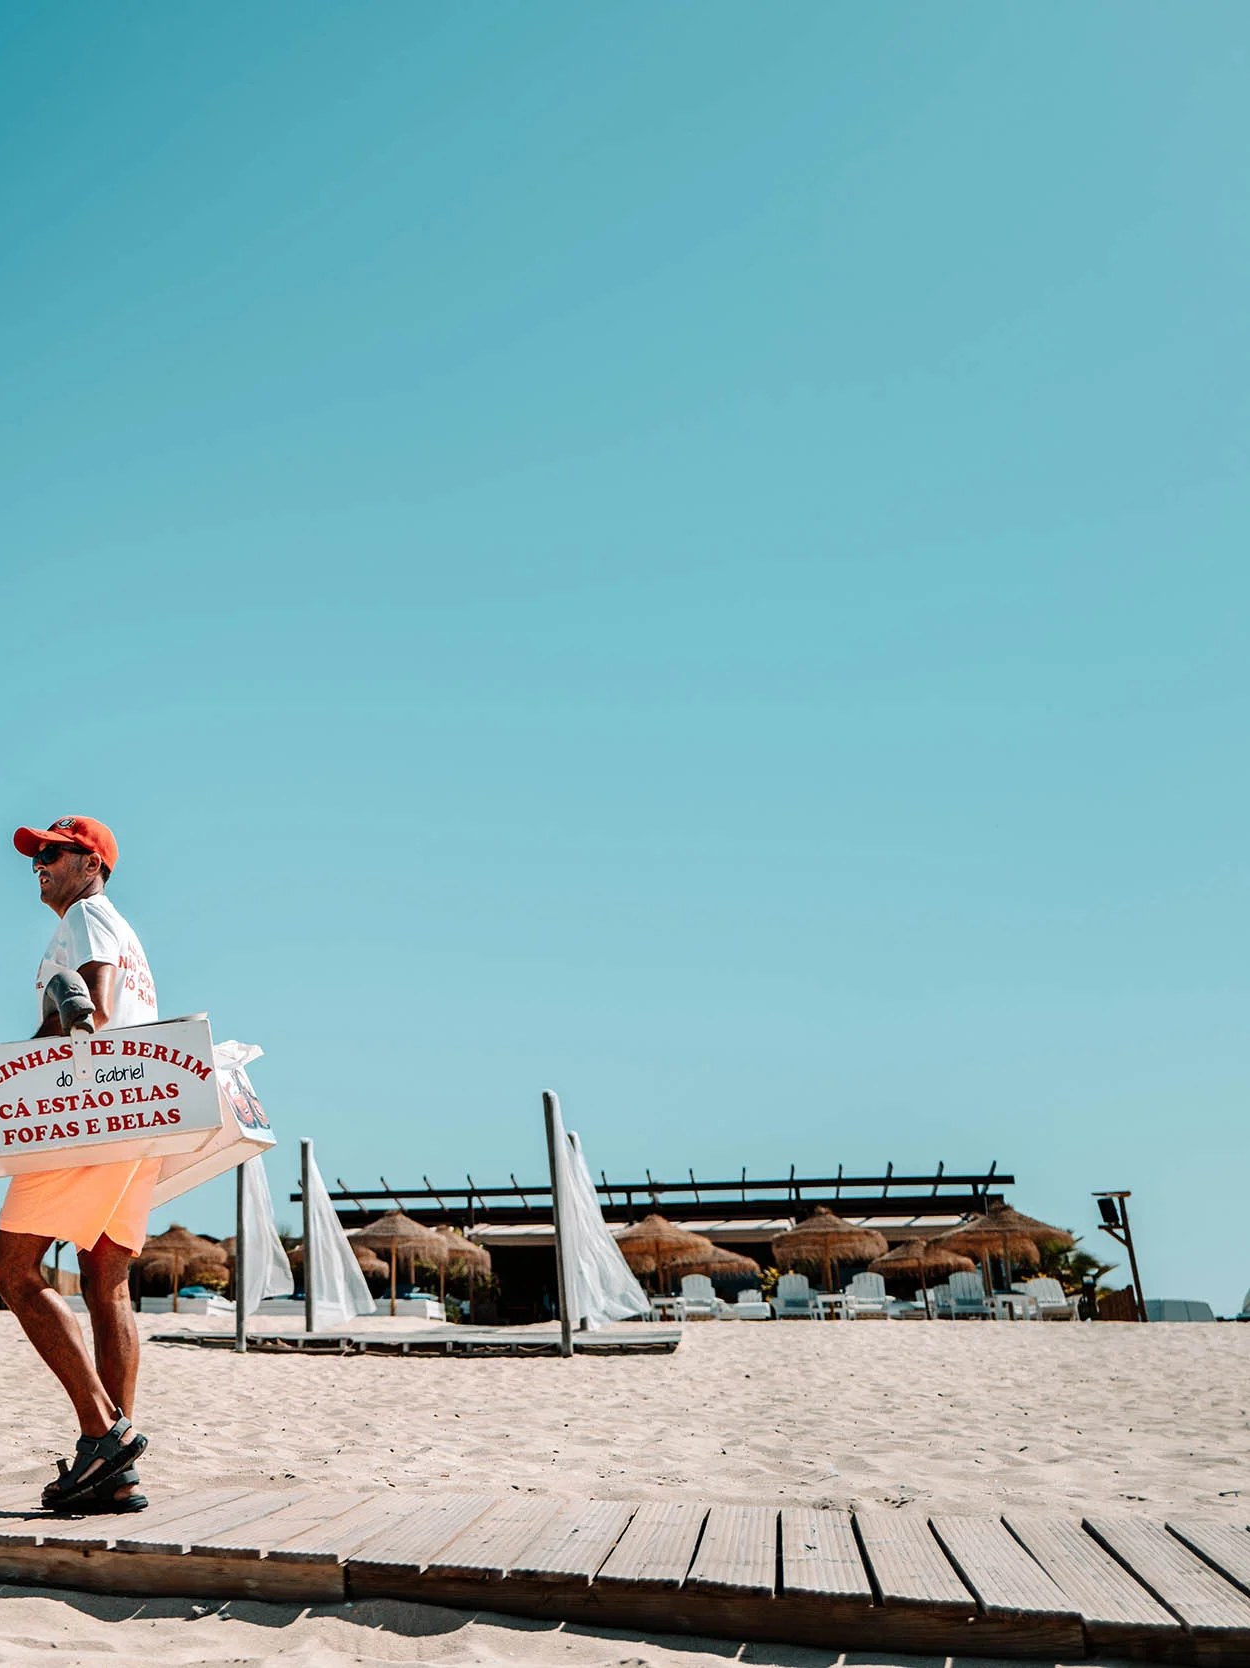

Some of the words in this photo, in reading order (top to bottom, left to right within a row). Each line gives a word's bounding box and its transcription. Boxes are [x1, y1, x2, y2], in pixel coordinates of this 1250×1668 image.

[56, 1070, 74, 1088] do
[94, 1062, 145, 1084] Gabriel
[90, 1040, 115, 1056] DE
[121, 1040, 212, 1081] BERLIM
[37, 1090, 114, 1115] ESTÃO
[119, 1083, 179, 1105] ELAS
[3, 1121, 80, 1146] FOFAS
[85, 1118, 101, 1135] E
[106, 1108, 181, 1133] BELAS
